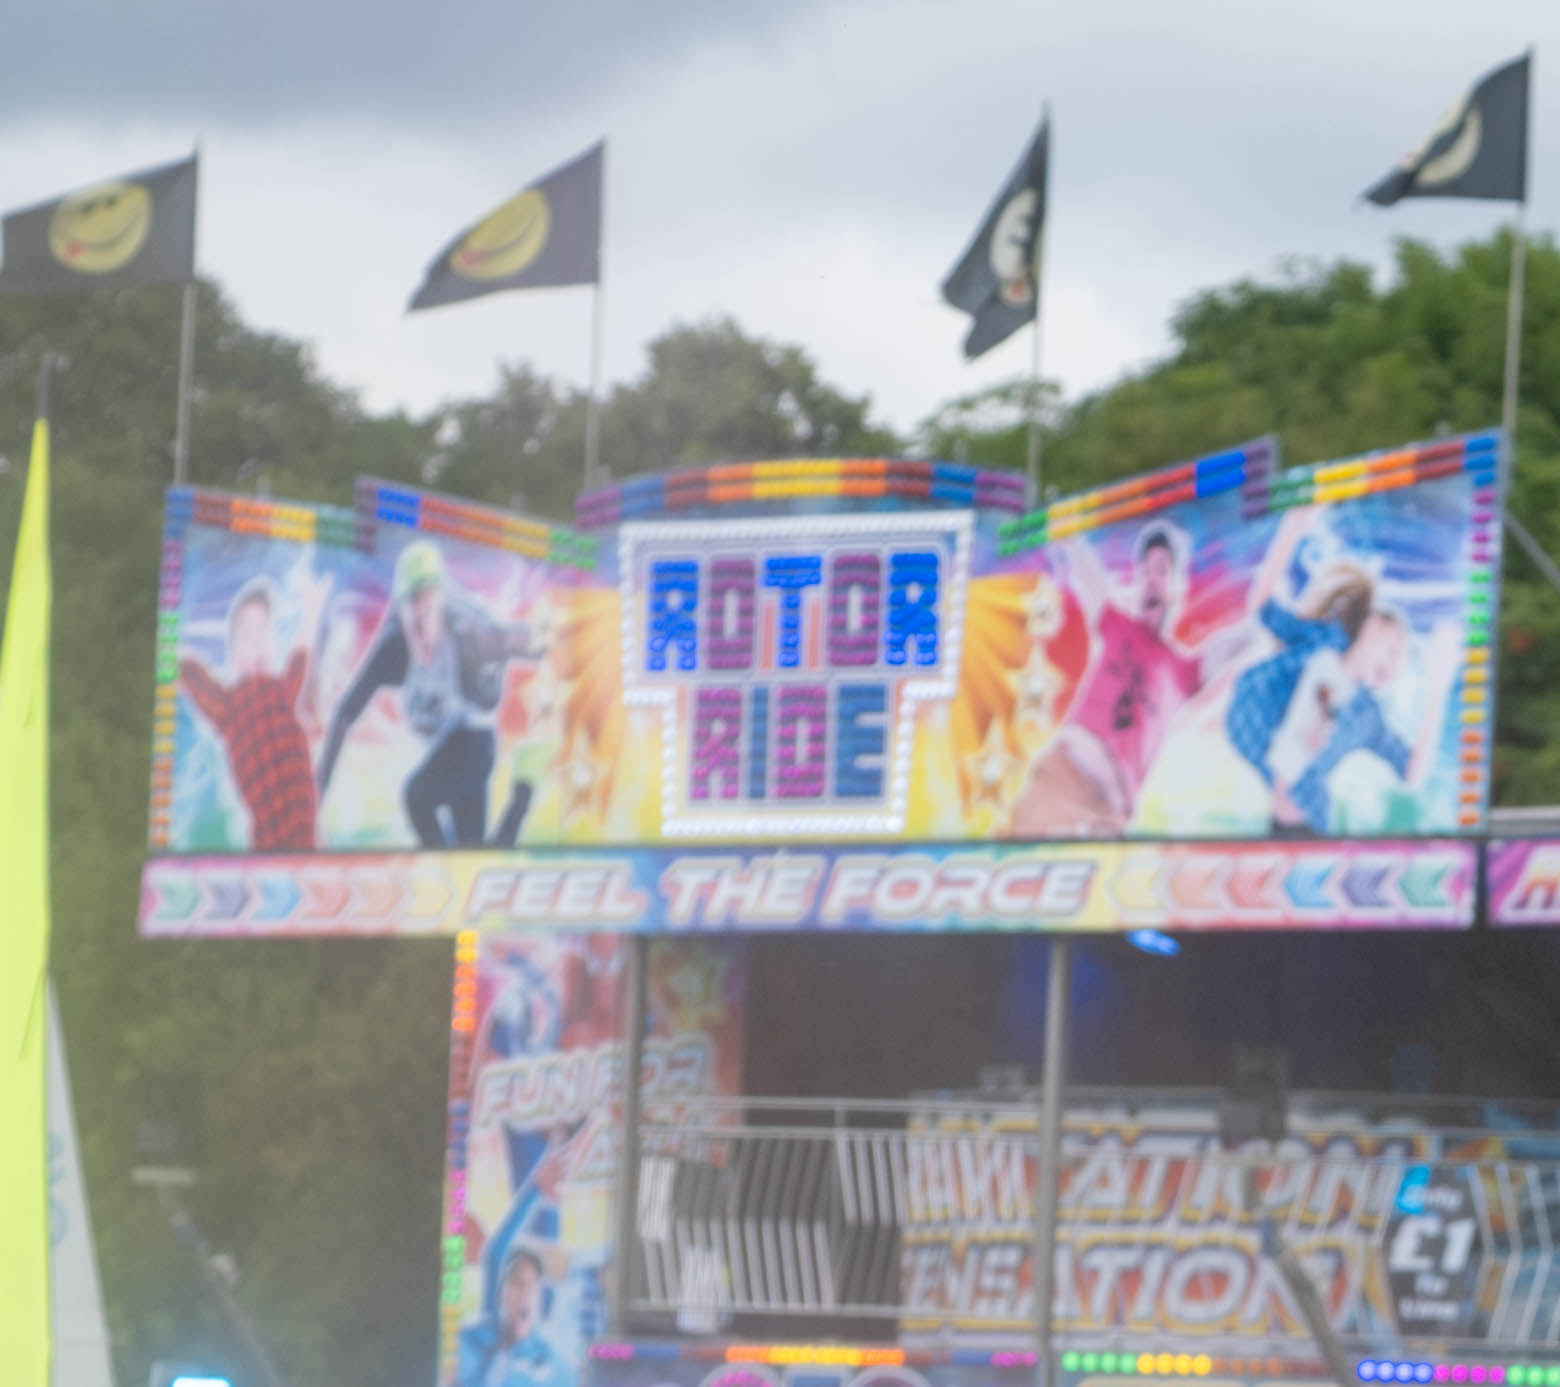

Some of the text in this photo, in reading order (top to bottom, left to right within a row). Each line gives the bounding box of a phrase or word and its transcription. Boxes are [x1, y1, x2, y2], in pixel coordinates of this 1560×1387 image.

[647, 552, 942, 671] ROTOR
[692, 683, 889, 802] RIDE
[470, 850, 1096, 923] FEEL THE FORCE
